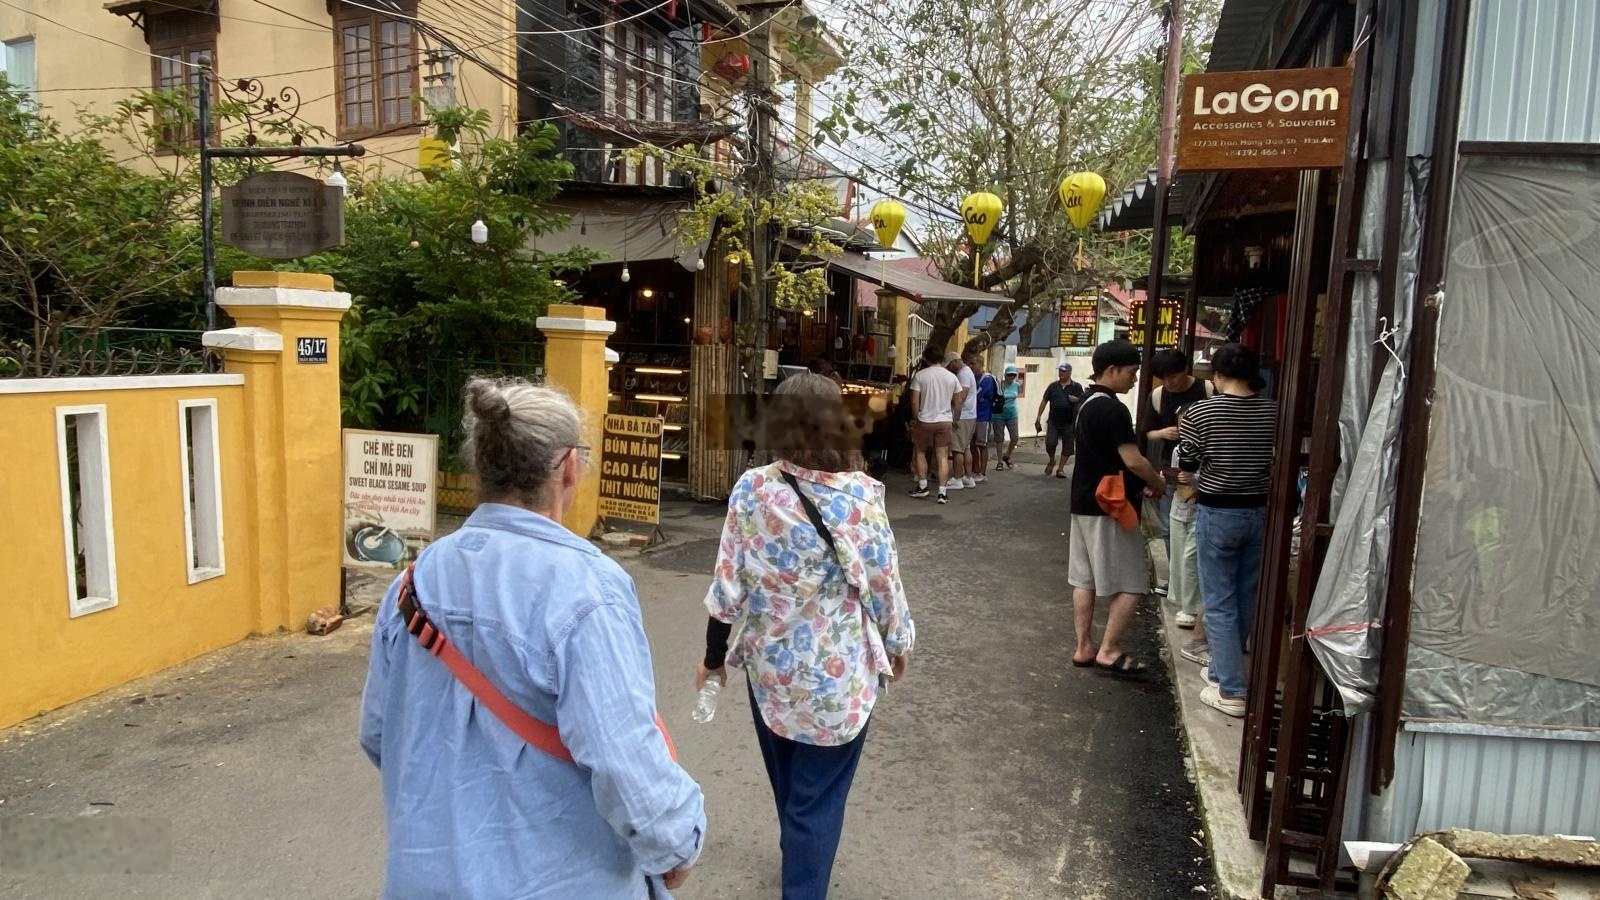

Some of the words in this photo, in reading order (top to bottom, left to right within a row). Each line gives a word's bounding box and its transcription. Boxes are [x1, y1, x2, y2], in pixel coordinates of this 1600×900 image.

[1193, 83, 1339, 115] LaGom
[1193, 120, 1263, 131] Accessories
[1266, 119, 1275, 128] &
[1278, 117, 1336, 128] Souvenirs
[964, 206, 987, 226] Cao
[298, 338, 326, 356] 45/17
[607, 417, 625, 431] NHÀ
[396, 442, 414, 459] ĐEN
[604, 436, 628, 455] BÚN
[630, 437, 658, 459] MẮM
[395, 460, 412, 478] PHÙ
[603, 460, 629, 477] CAO
[349, 476, 368, 488] SWEET
[368, 478, 387, 490] BLACK
[387, 480, 410, 492] SESAME
[411, 482, 427, 493] SOUP
[601, 479, 622, 498] THỊT
[623, 481, 658, 501] NƯỚNG
[382, 504, 389, 512] of
[400, 505, 408, 514] An
[409, 506, 420, 515] city
